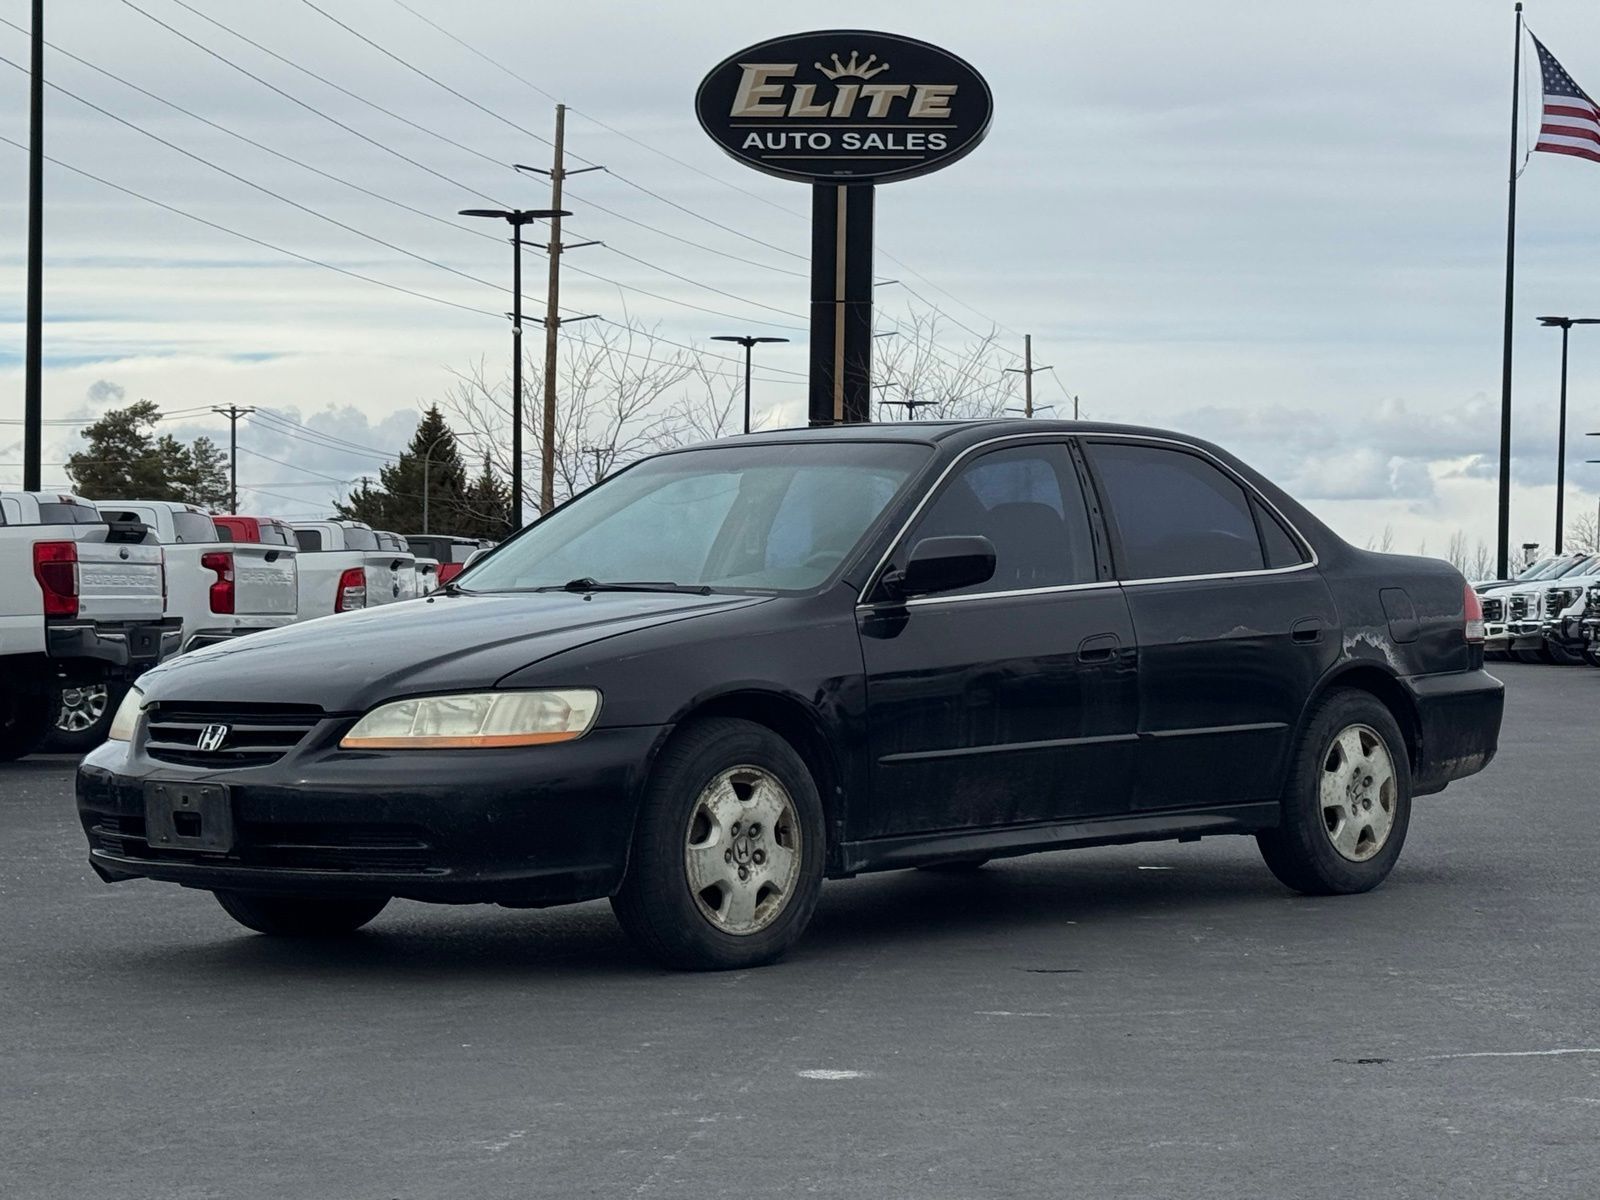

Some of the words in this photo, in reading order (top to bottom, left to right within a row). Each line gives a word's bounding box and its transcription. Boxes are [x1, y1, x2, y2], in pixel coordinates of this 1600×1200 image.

[729, 63, 959, 119] ELITE
[742, 132, 832, 150] AUTO
[842, 132, 948, 151] SALES
